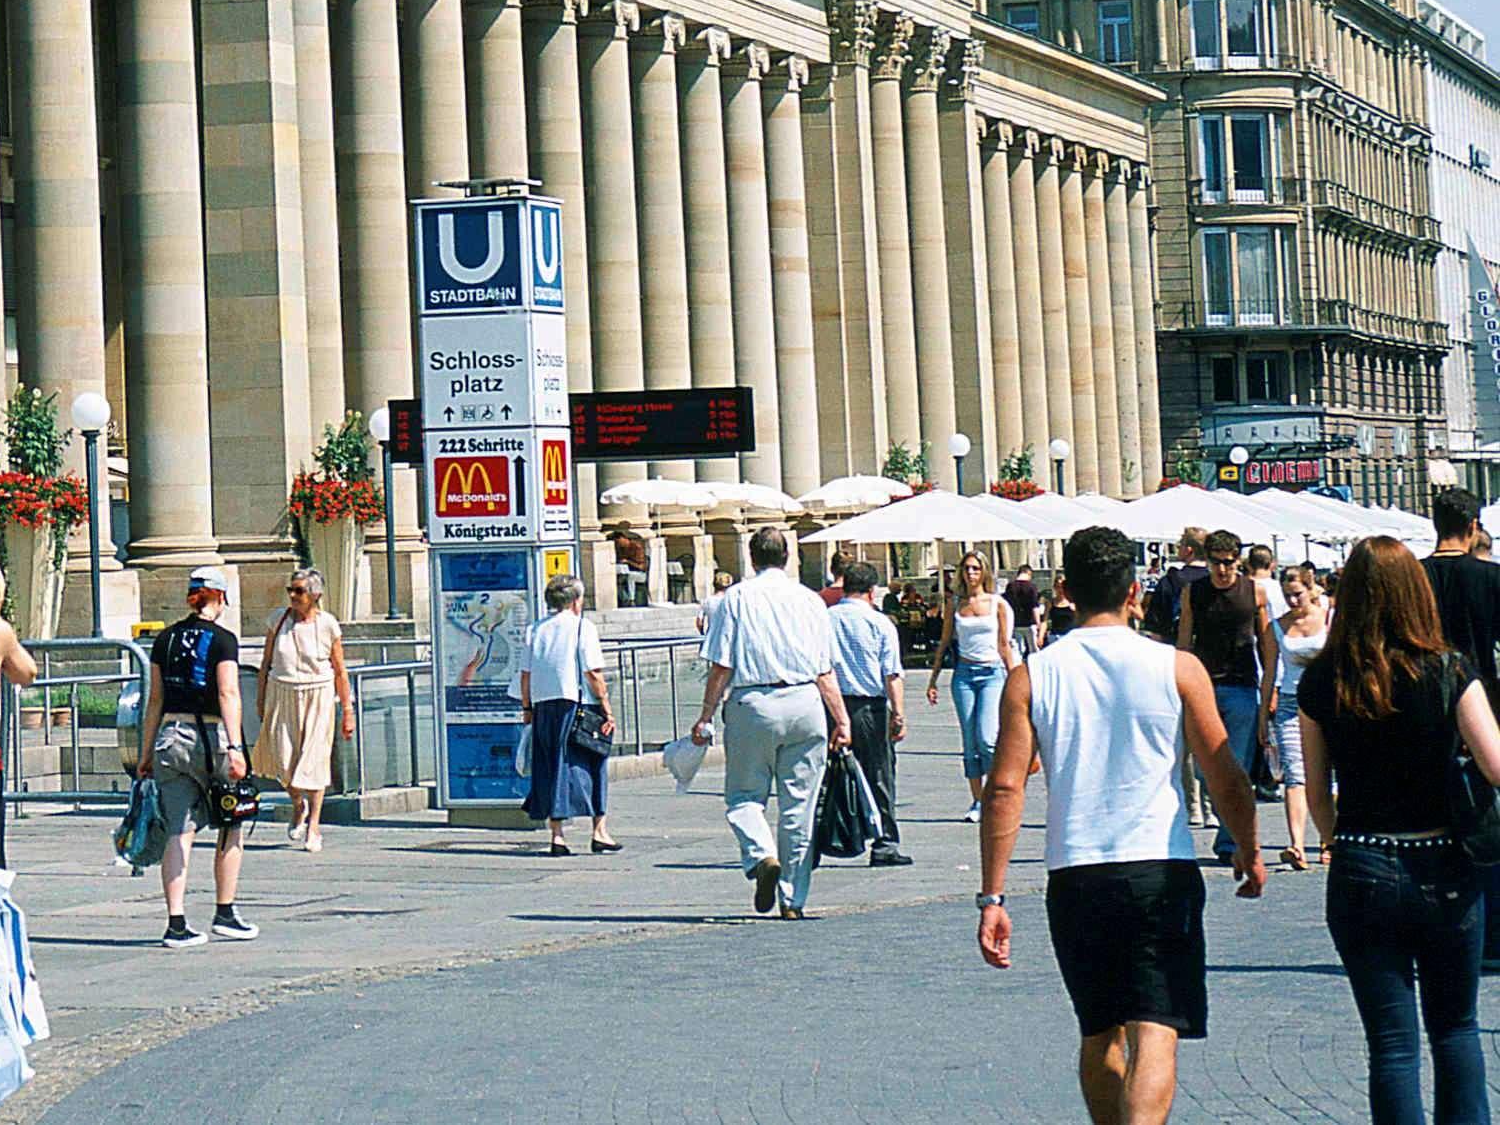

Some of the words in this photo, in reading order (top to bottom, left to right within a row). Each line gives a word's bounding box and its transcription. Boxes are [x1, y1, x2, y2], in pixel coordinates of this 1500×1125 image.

[438, 210, 504, 284] U
[534, 210, 558, 284] U
[430, 287, 516, 303] STADTBAHN
[430, 350, 523, 371] Schloss-
[451, 374, 504, 398] platz
[439, 439, 465, 453] 222
[467, 438, 524, 452] Schritte
[444, 524, 527, 540] Königstraße
